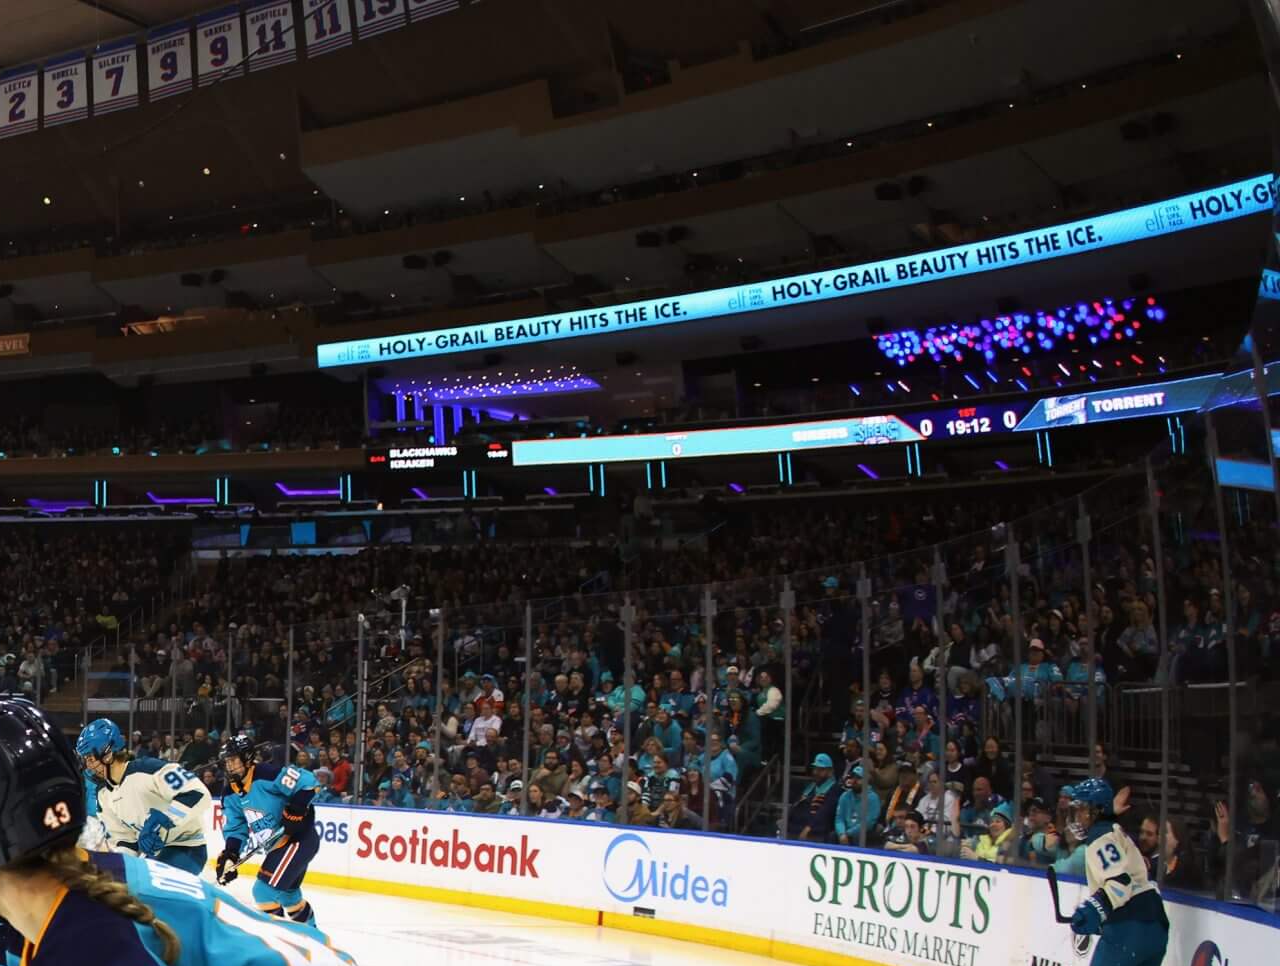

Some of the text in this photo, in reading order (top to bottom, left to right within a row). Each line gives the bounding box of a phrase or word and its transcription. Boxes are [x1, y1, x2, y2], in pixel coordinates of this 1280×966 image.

[311, 2, 342, 41] 11
[210, 35, 229, 67] 9
[255, 19, 286, 56] 11
[105, 65, 125, 97] 7
[159, 50, 178, 81] 9
[8, 92, 27, 123] 2
[56, 79, 75, 109] 3
[771, 224, 1104, 302] HOLY-GRAIL BEAUTY HITS THE ICE.
[378, 299, 688, 359] HOLY-GRAIL BEAUTY HITS THE ICE.
[1091, 392, 1165, 413] TORRENT
[919, 419, 934, 437] 0
[946, 416, 991, 436] 19:12
[1002, 410, 1017, 429] 0
[389, 446, 458, 459] BLACKHAWKS
[390, 458, 435, 469] KRAKEN
[42, 801, 71, 829] 43
[355, 819, 540, 879] Scotiabank
[1096, 842, 1121, 871] 13
[628, 858, 729, 908] Midea
[807, 853, 993, 935] SPROUTS
[812, 912, 898, 952] FARMERS
